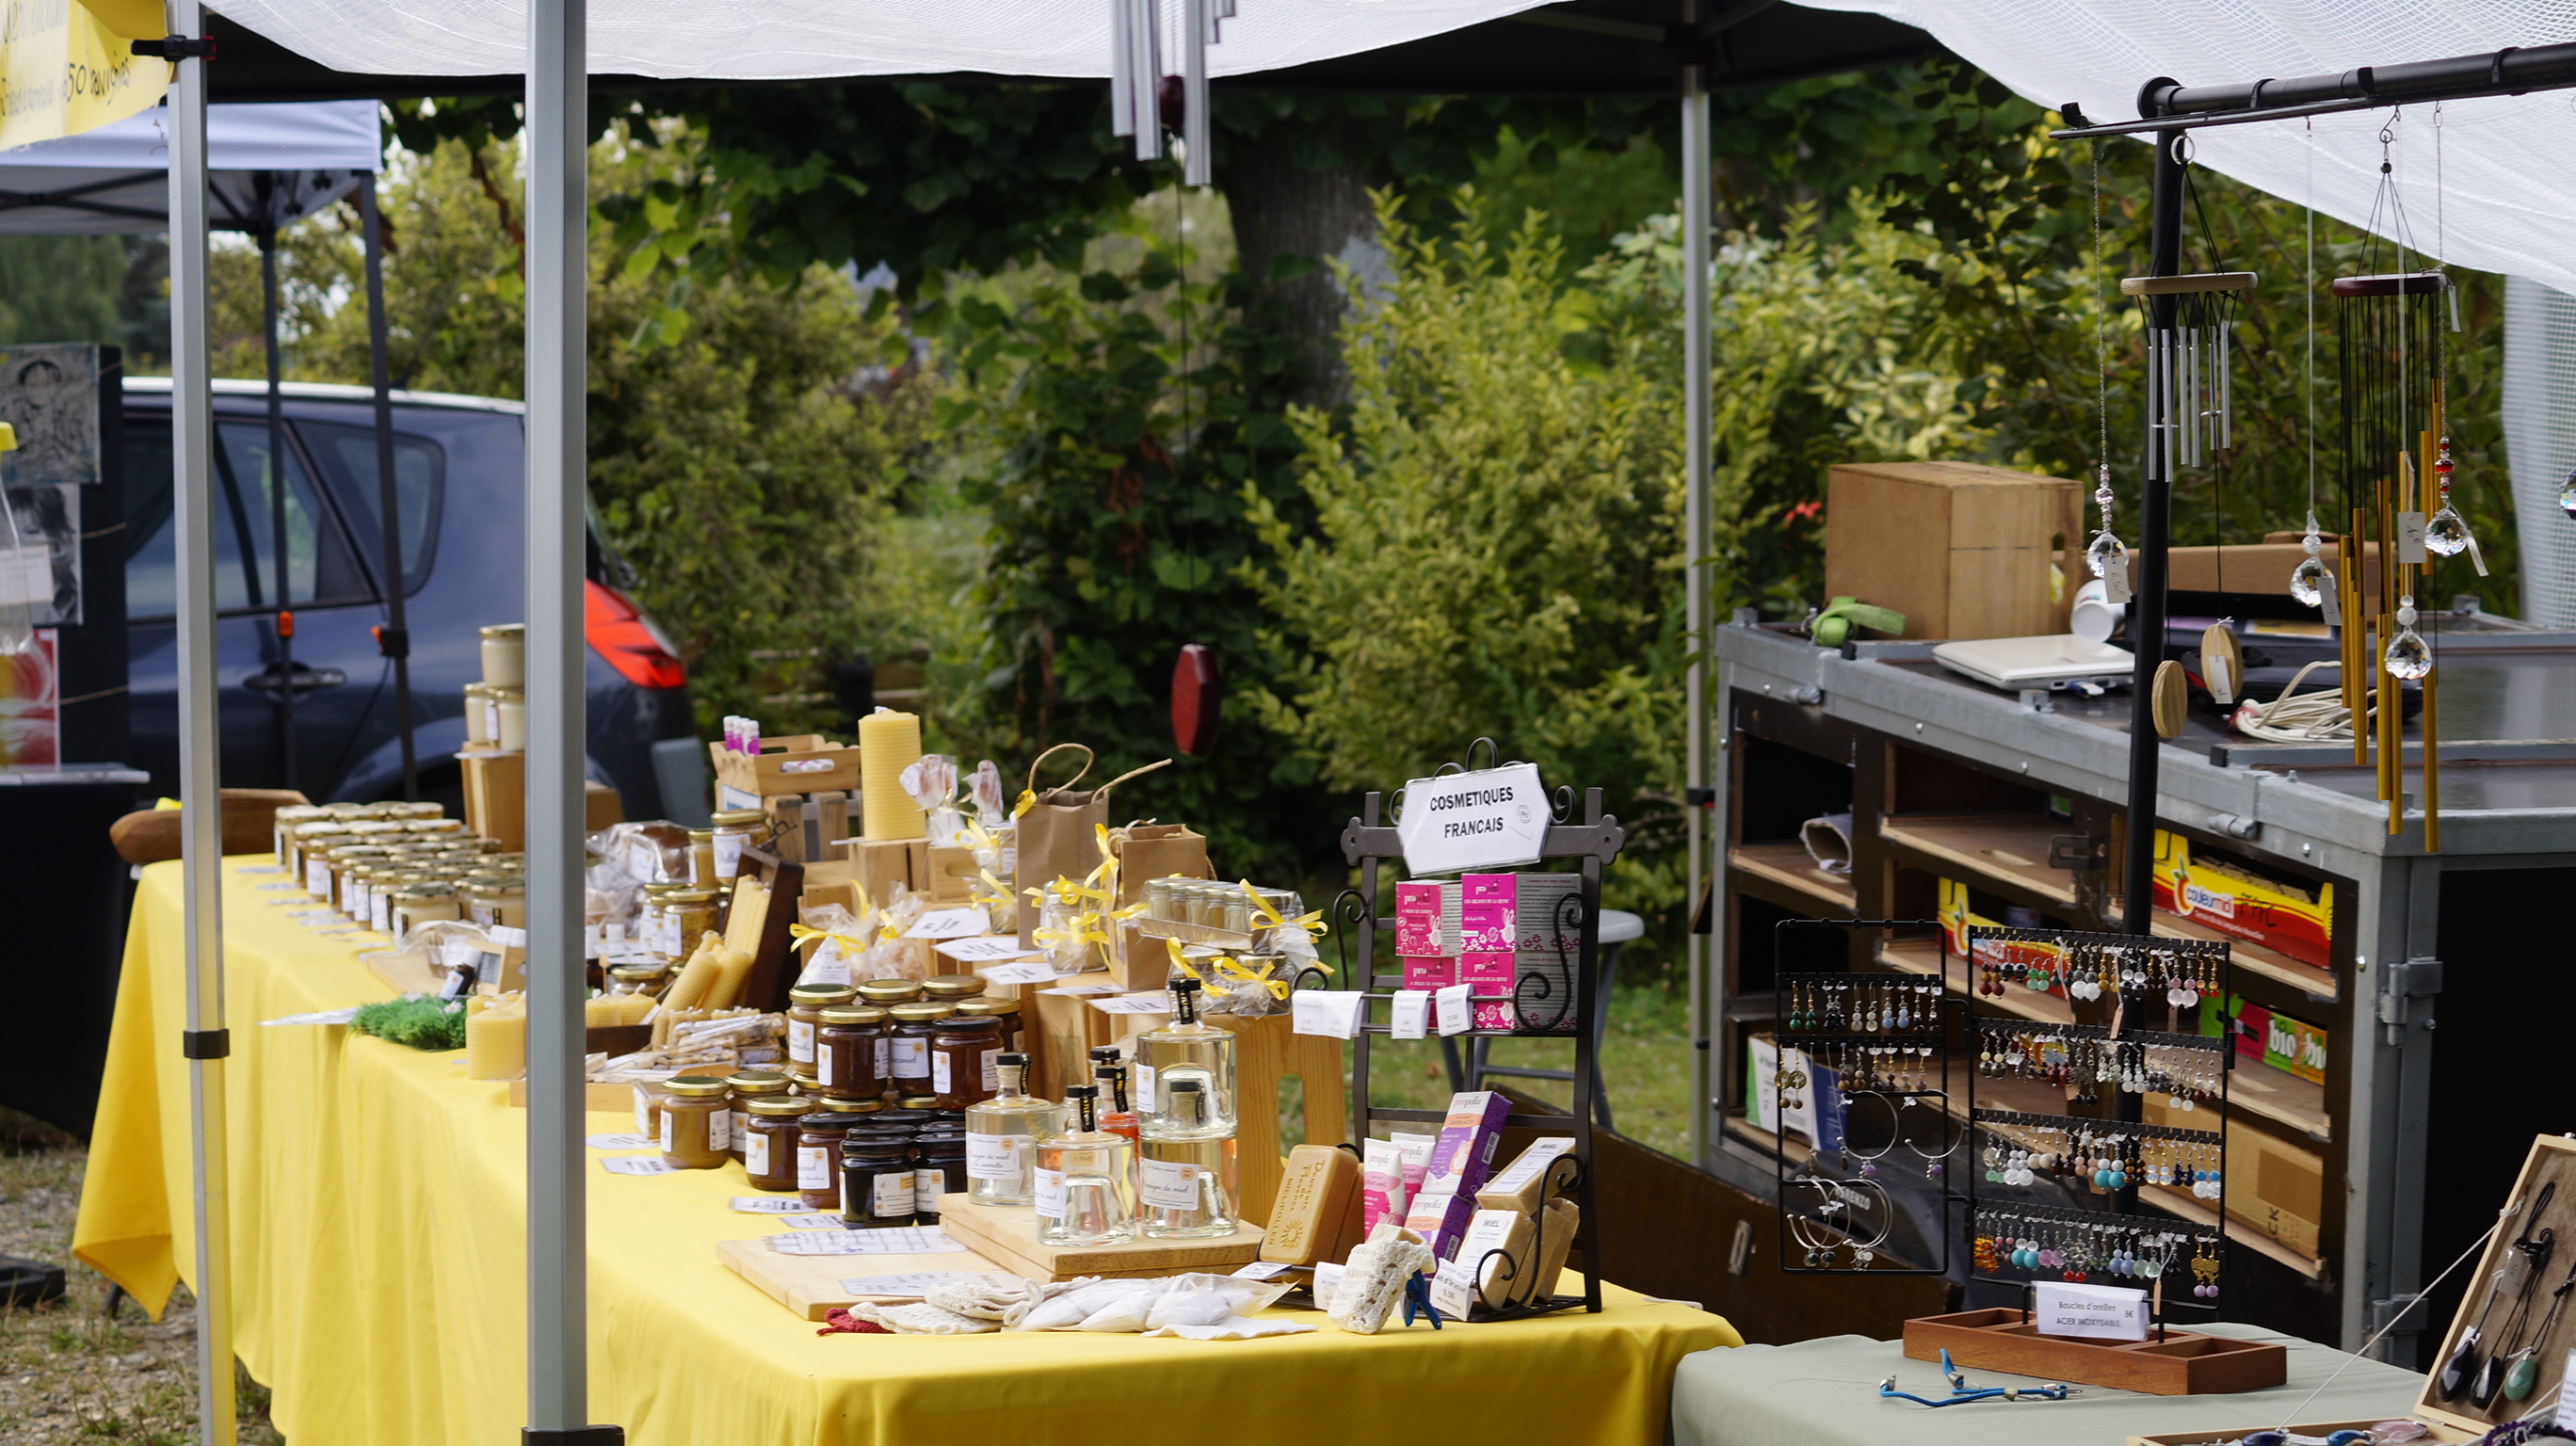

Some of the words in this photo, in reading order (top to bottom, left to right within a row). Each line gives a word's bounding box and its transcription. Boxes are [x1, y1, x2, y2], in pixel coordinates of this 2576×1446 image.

[1430, 786, 1514, 811] COSMETIQUES
[1444, 817, 1504, 838] FRANCAIS
[2268, 1019, 2296, 1058] bio
[2058, 1301, 2085, 1310] Boucles
[2086, 1301, 2117, 1311] d'oreilles
[2056, 1317, 2076, 1326] ACIER
[2078, 1318, 2121, 1327] INOXYDABLE
